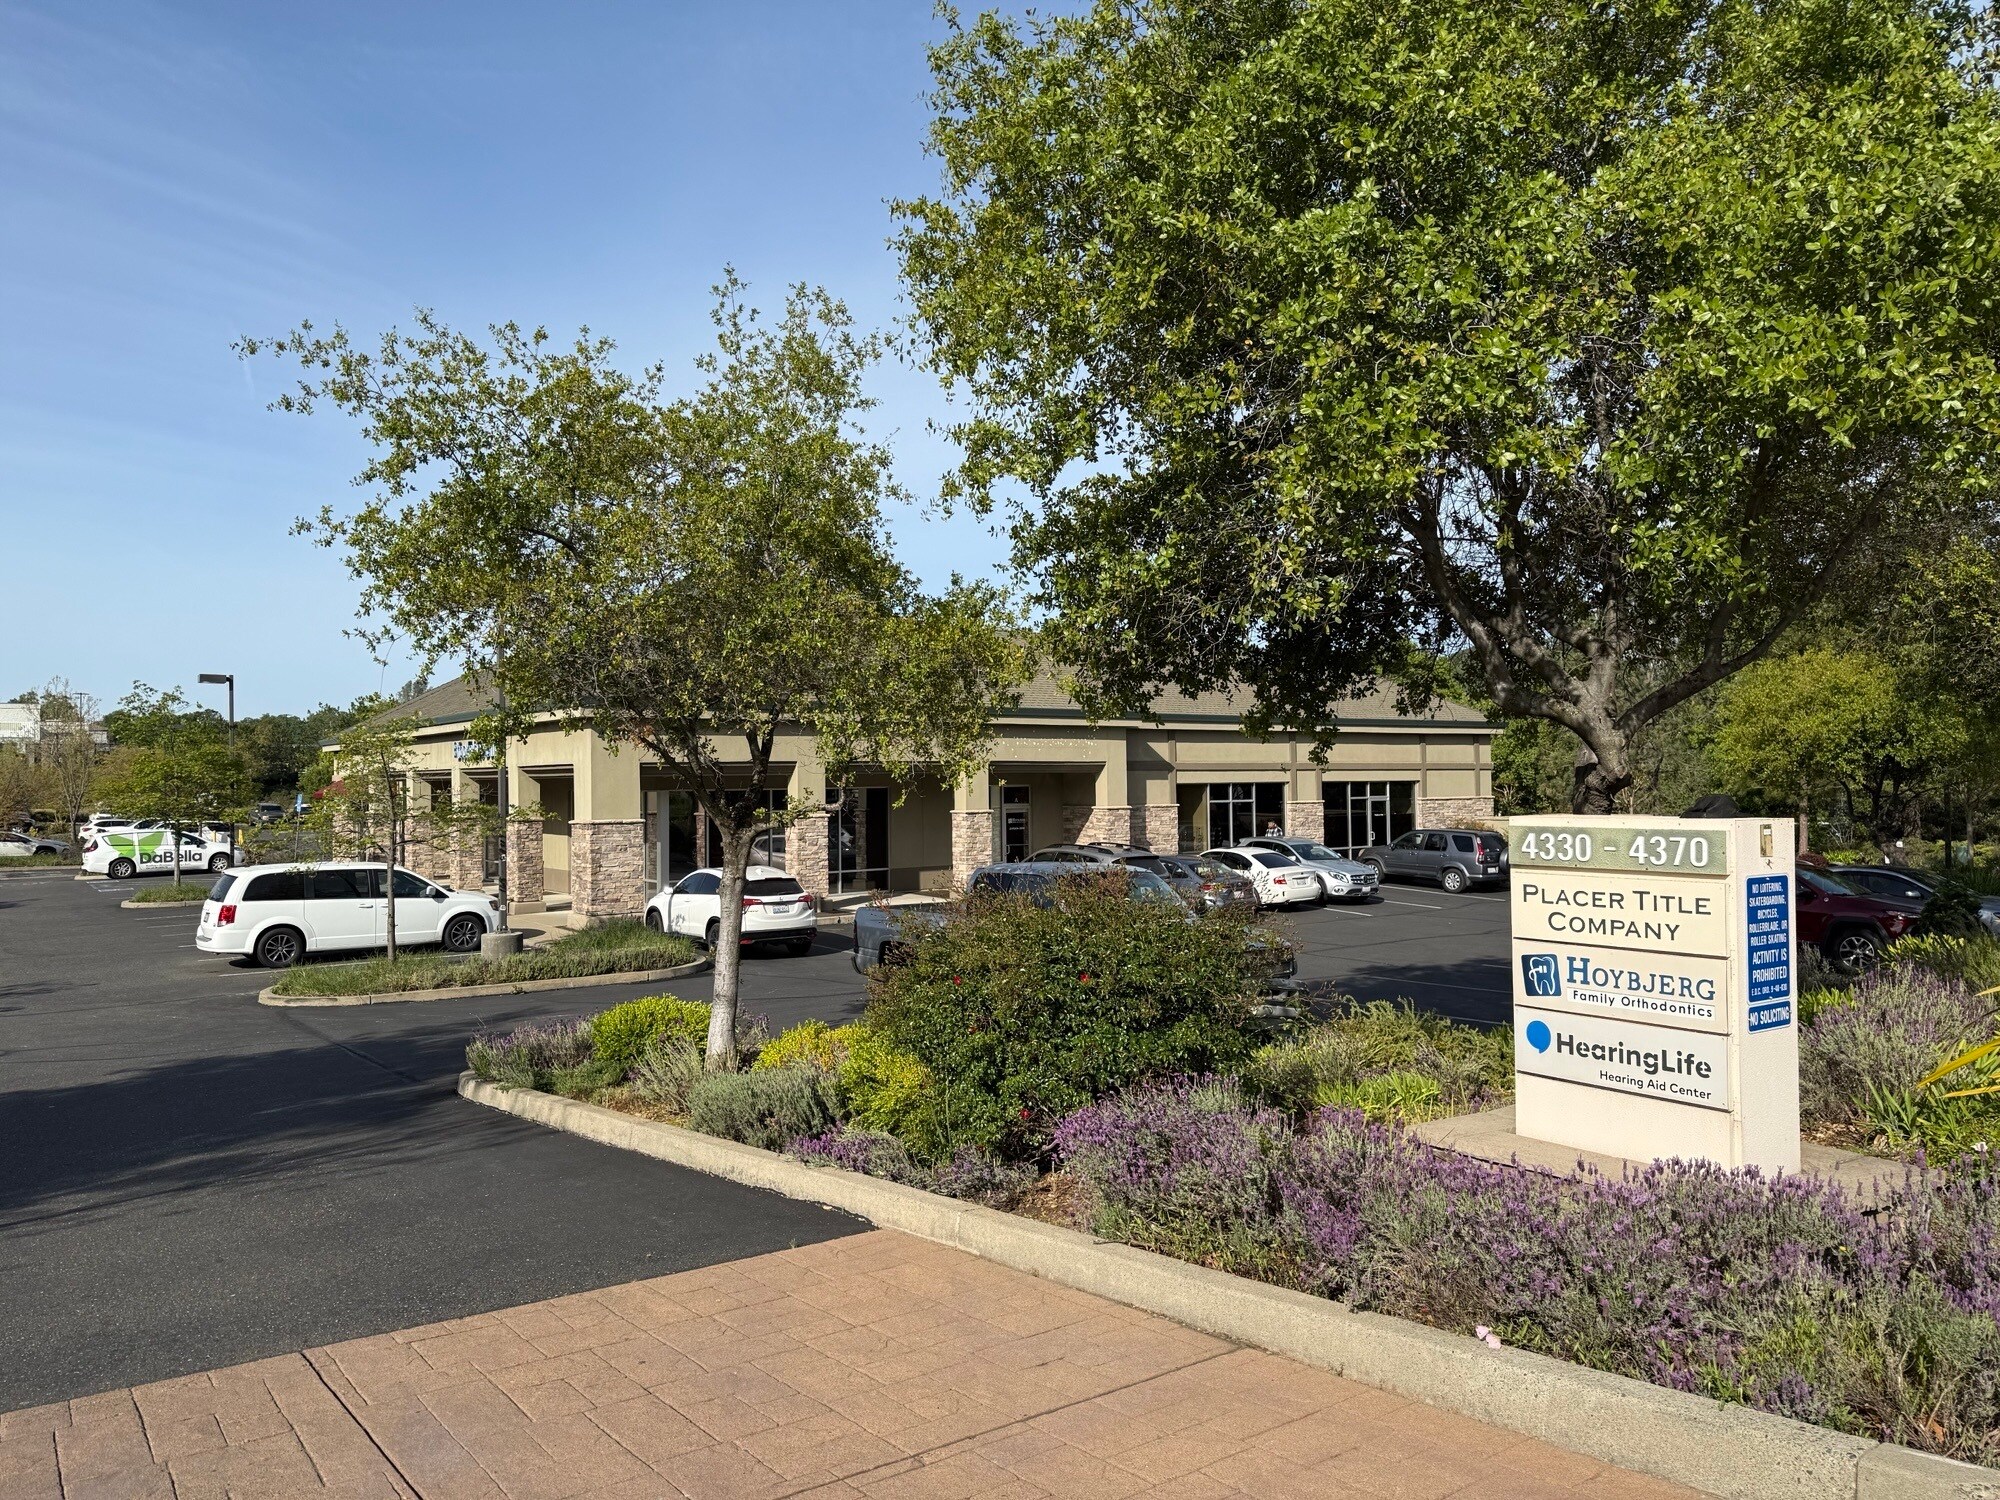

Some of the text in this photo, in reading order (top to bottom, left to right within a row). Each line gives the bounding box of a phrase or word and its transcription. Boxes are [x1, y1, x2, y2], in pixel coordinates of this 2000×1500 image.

[140, 850, 202, 864] DaBella
[1521, 832, 1592, 862] 4330
[1629, 836, 1709, 867] 4370
[1523, 884, 1712, 916] PLACER TITLE
[1752, 884, 1760, 893] NO
[1548, 911, 1680, 941] COMPANY
[1781, 920, 1788, 930] OR
[1750, 933, 1787, 946] ROLLER SKATING
[1752, 948, 1787, 965] ACTIVITY IS
[1566, 956, 1715, 1001] HOYBJERG
[1752, 966, 1788, 983] PROHIBITED
[1573, 990, 1713, 1018] Family Orthodontics
[1750, 1006, 1789, 1026] NO SOLICITING
[1556, 1032, 1712, 1079] HearingLife
[1600, 1069, 1712, 1099] Hearing Aid Center
